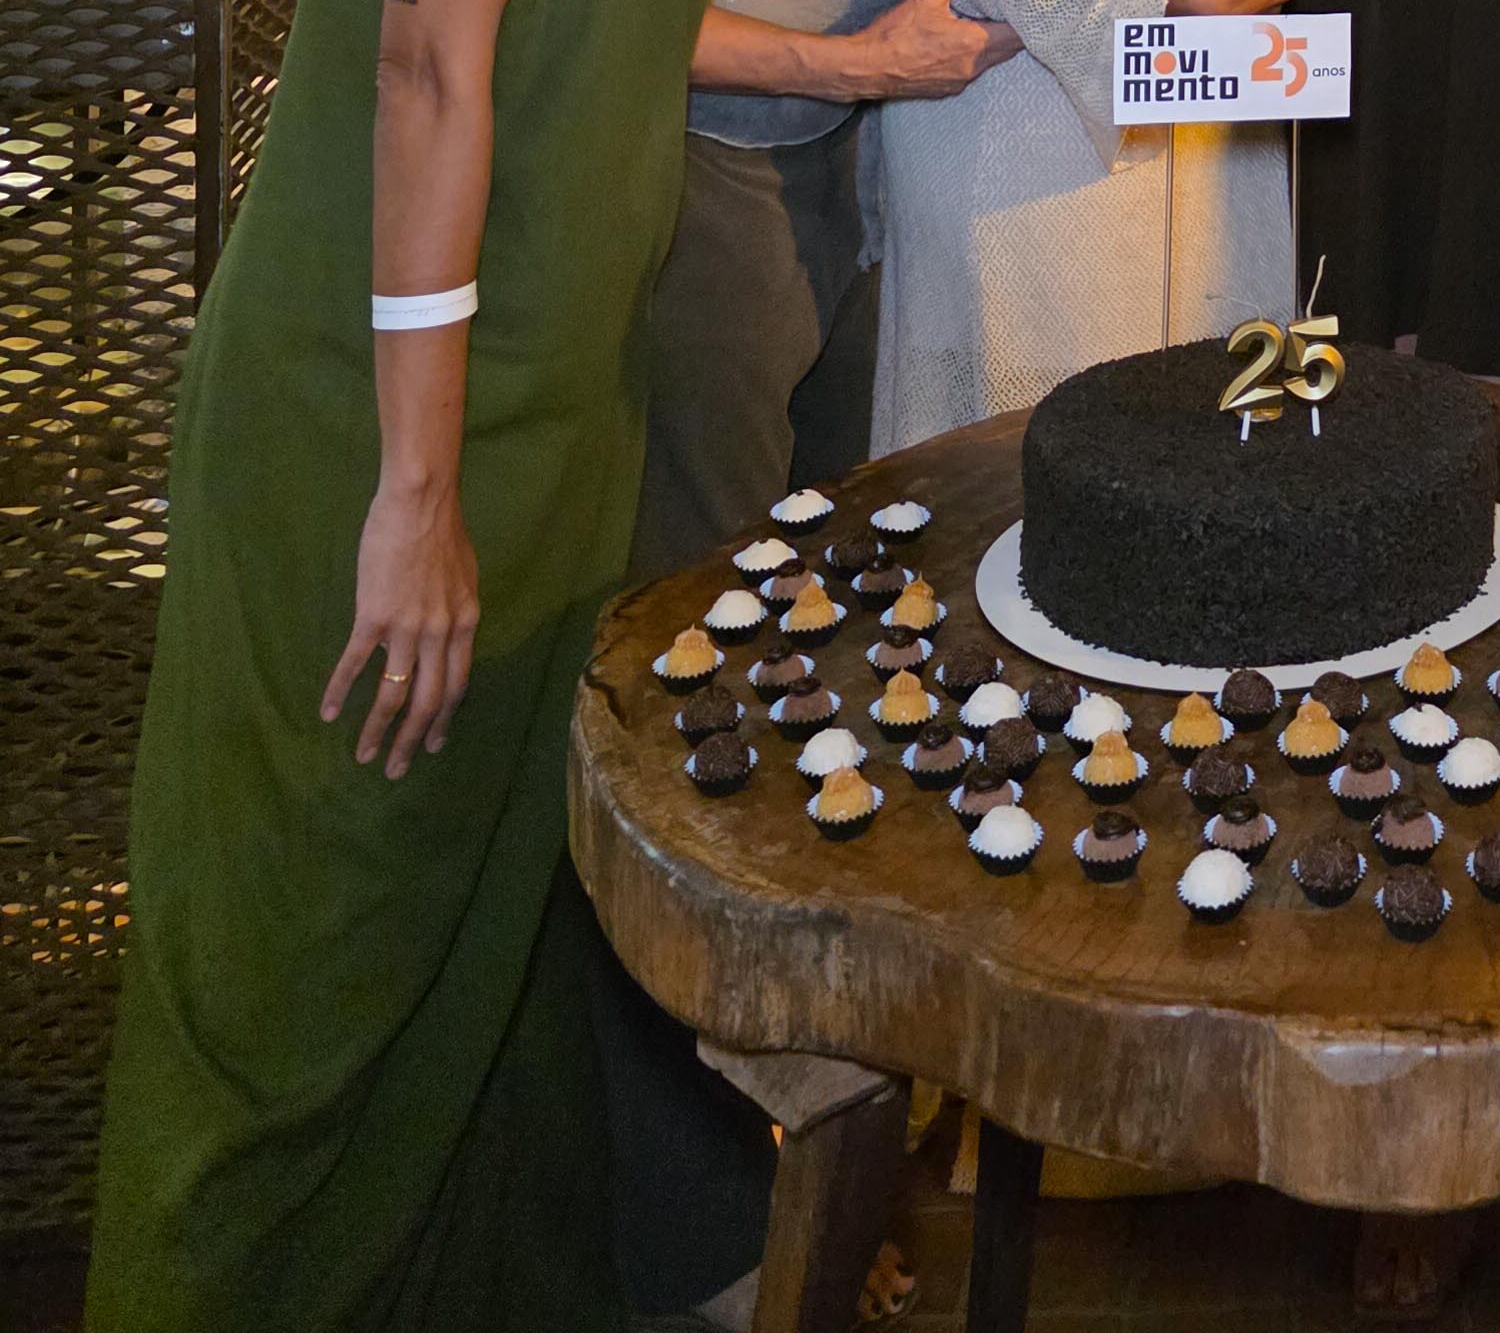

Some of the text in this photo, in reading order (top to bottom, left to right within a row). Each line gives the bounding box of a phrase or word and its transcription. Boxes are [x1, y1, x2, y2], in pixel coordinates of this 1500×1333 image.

[1124, 23, 1175, 47] em
[1250, 21, 1346, 97] 25 anos
[1123, 74, 1239, 102] mento
[1217, 314, 1346, 411] 25
